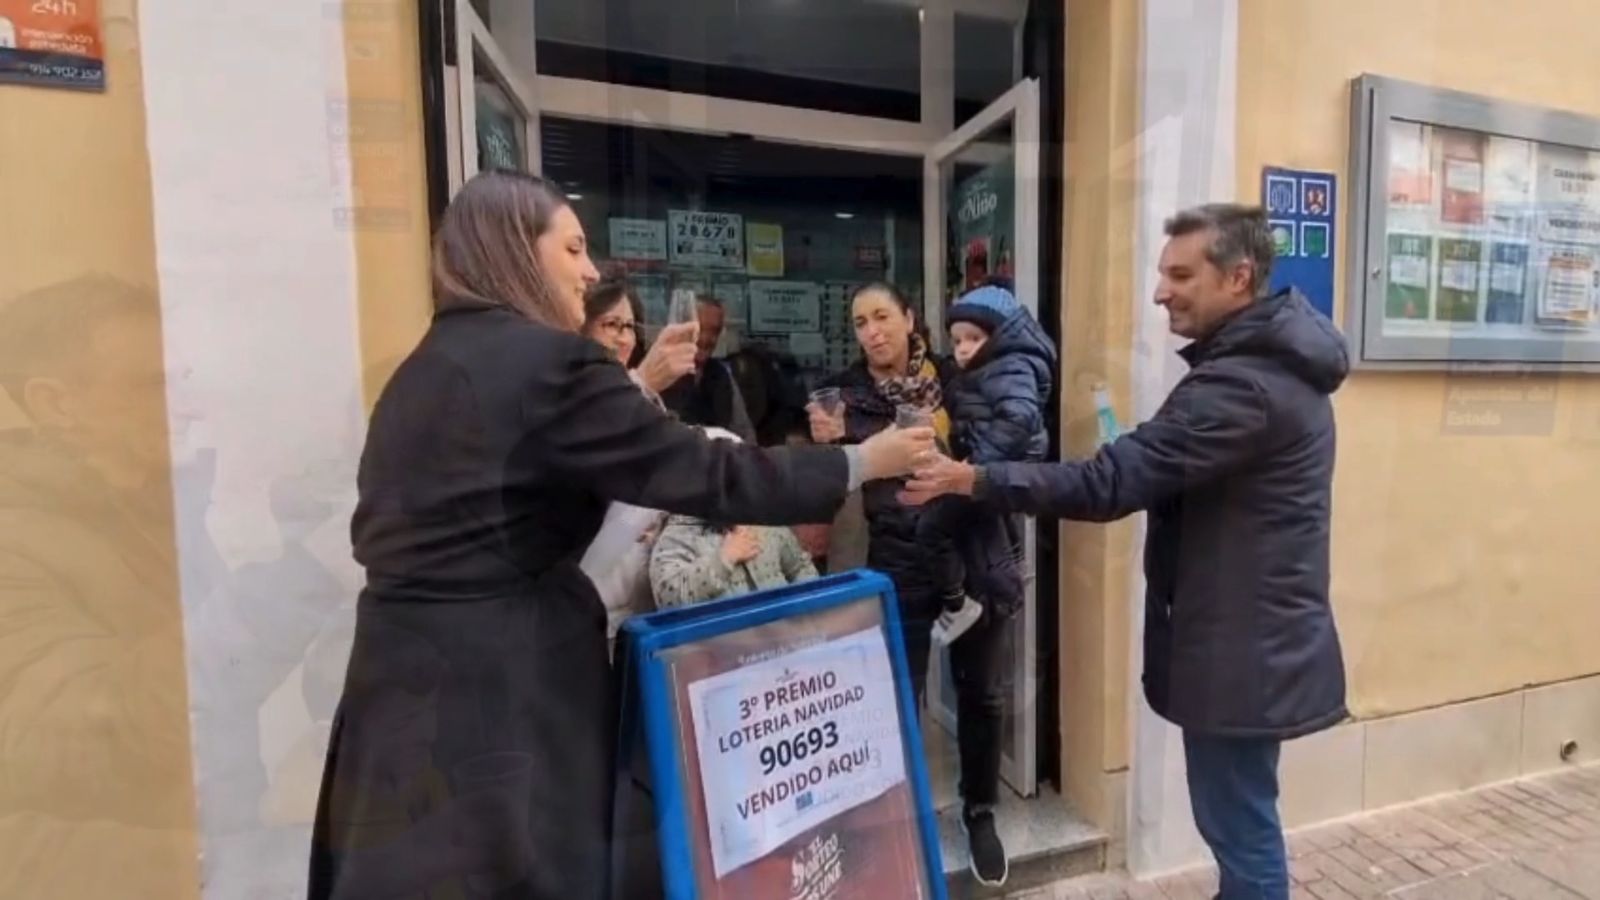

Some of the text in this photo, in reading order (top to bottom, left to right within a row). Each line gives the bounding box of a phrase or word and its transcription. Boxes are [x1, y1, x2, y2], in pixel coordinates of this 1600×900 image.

[1447, 410, 1502, 426] Estado
[764, 671, 836, 711] PREMIO
[719, 713, 790, 753] LOTERIA
[795, 685, 865, 724] NAVIDAD
[759, 721, 839, 775] 90693
[737, 766, 822, 821] VENDIDO
